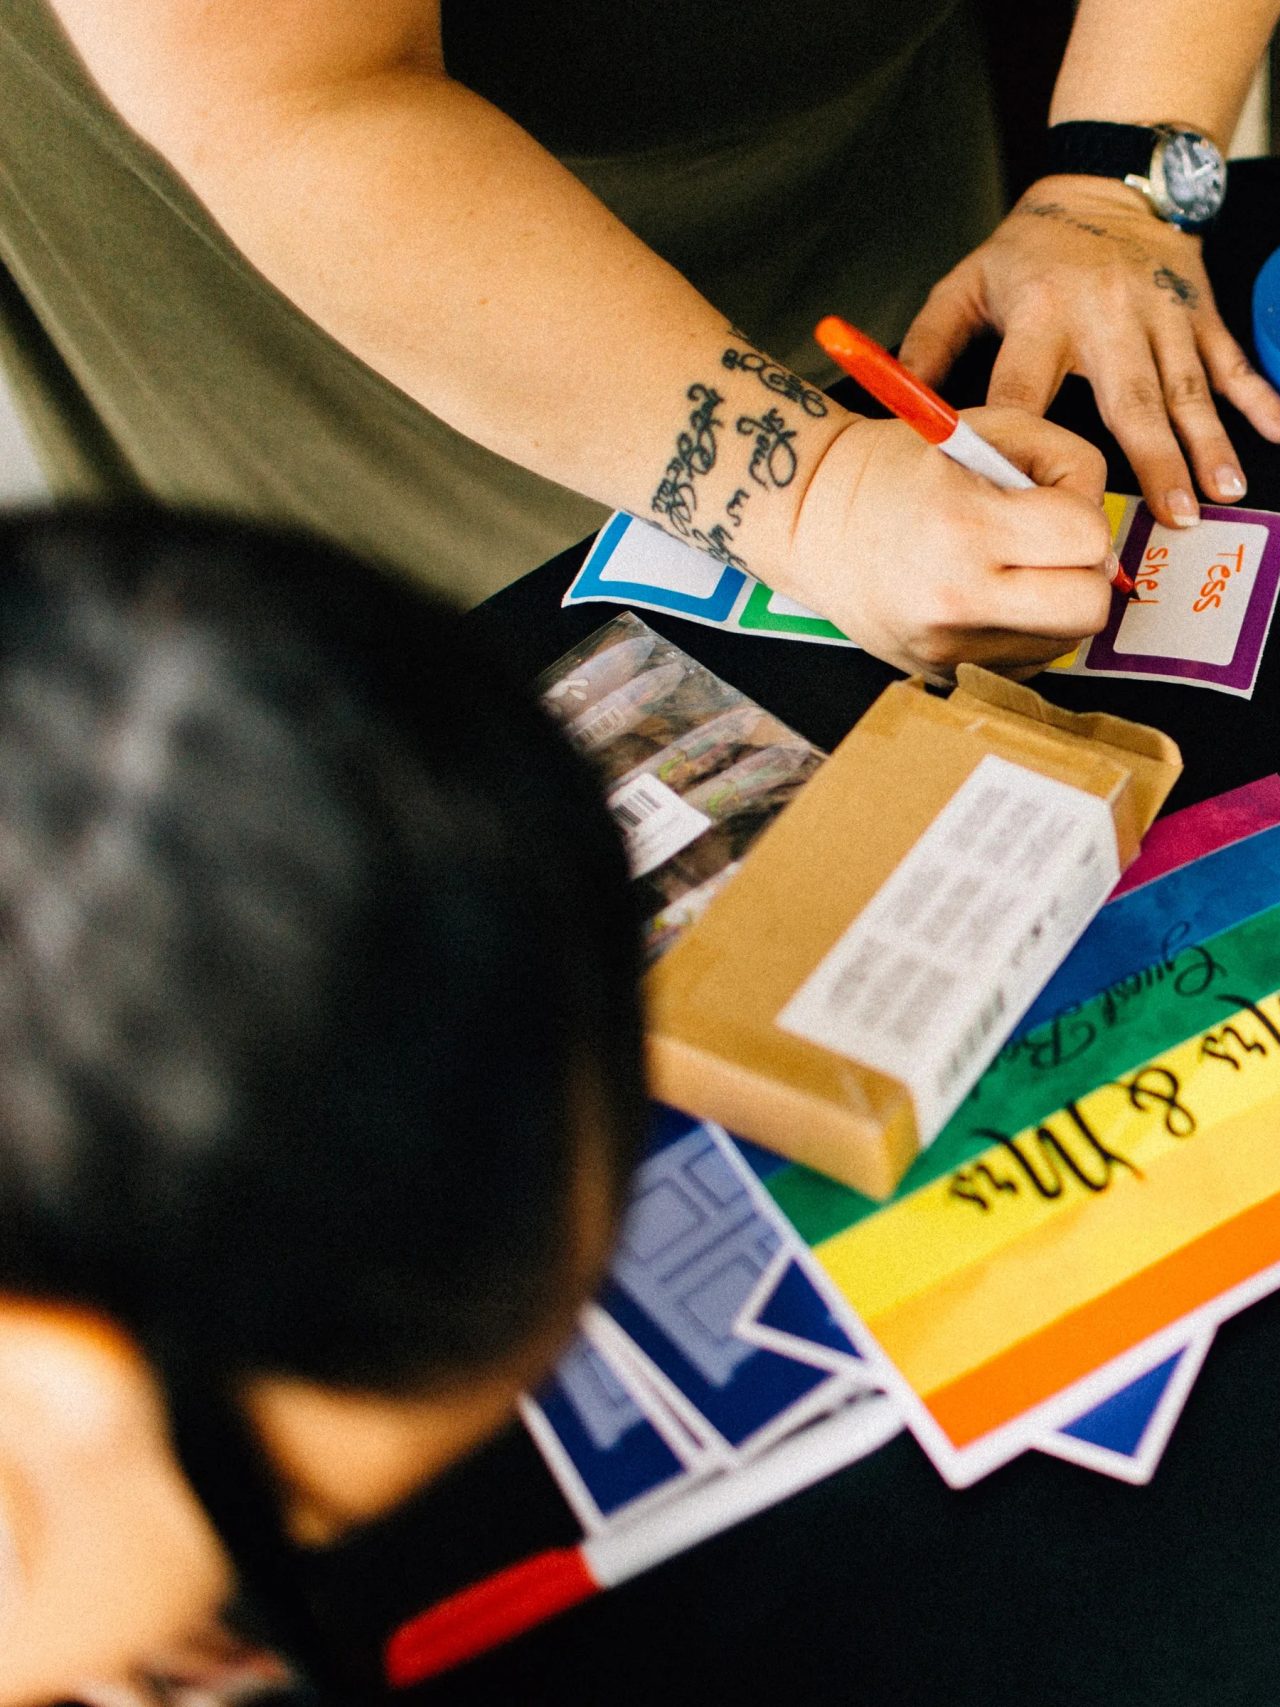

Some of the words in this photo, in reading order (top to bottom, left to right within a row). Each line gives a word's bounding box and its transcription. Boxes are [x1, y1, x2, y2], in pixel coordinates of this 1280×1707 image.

[1193, 544, 1244, 612] Tess
[1102, 921, 1228, 1027] Guest
[972, 1003, 1098, 1100] Bo
[1101, 1066, 1197, 1138] &
[949, 1101, 1146, 1212] Mrs
